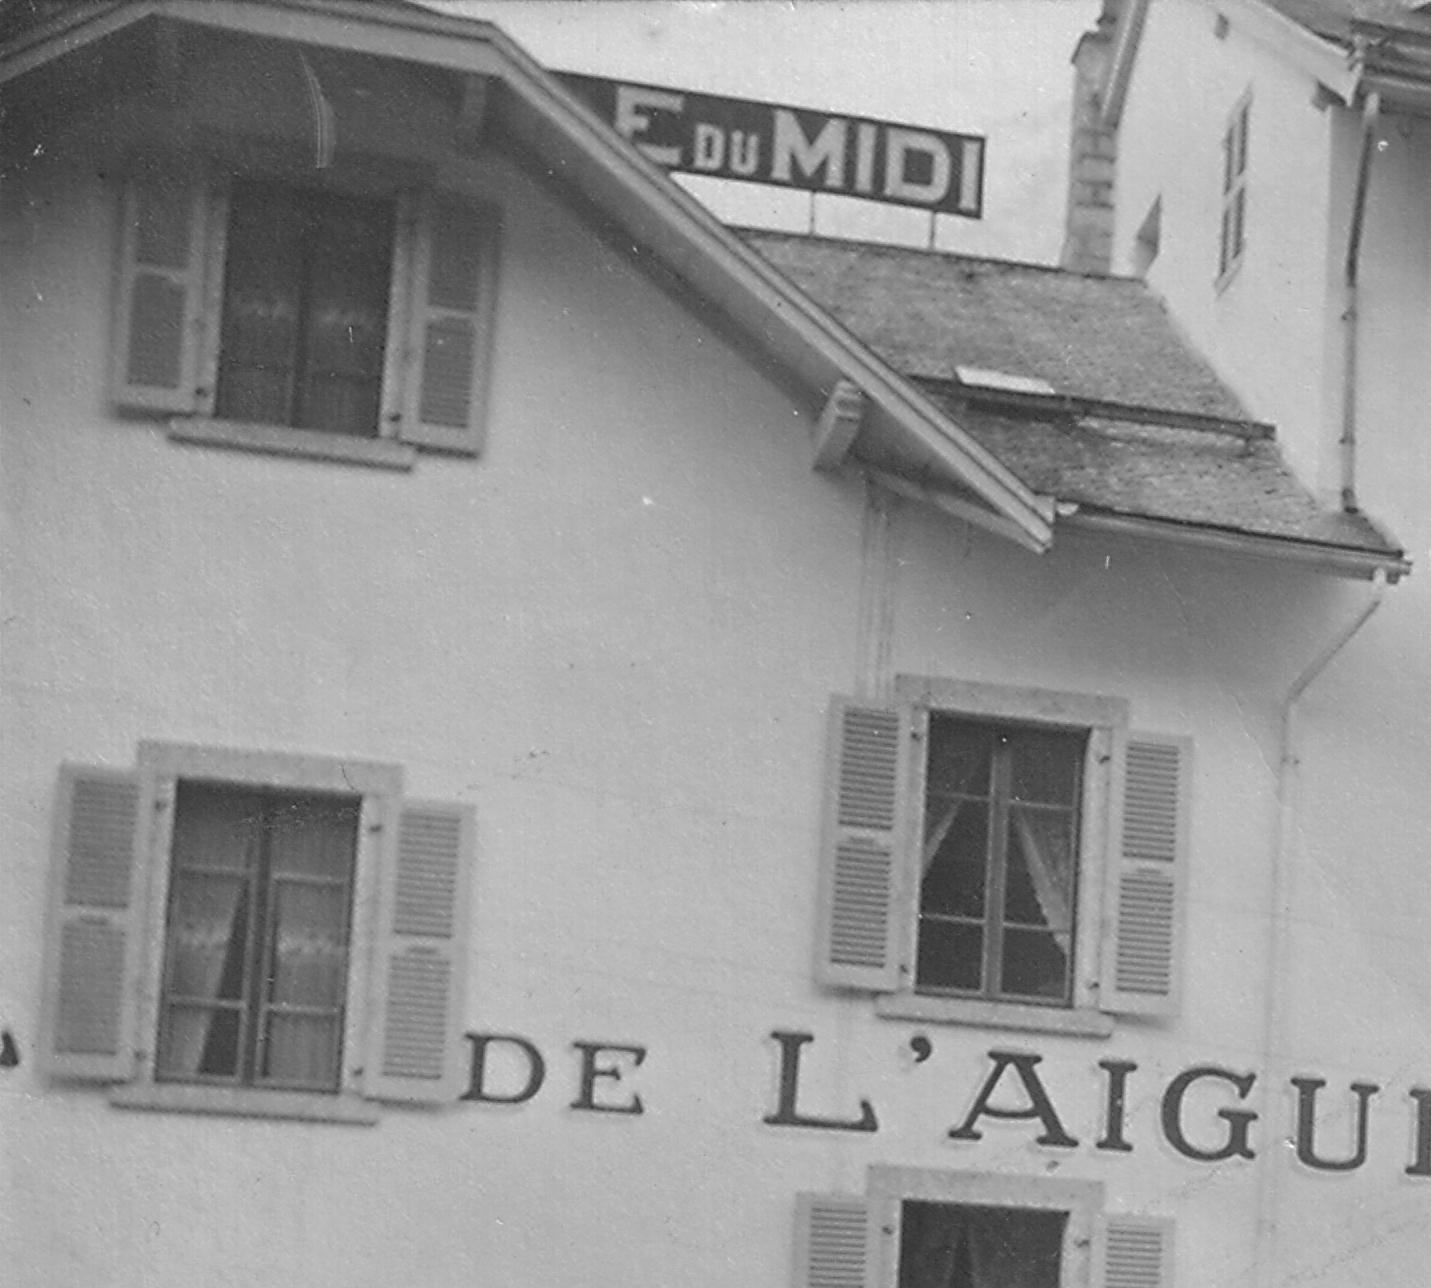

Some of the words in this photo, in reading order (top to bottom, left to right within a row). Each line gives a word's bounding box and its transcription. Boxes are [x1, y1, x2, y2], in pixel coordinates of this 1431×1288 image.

[693, 122, 759, 176] DU
[770, 108, 982, 212] MIDI
[457, 1031, 647, 1114] DE
